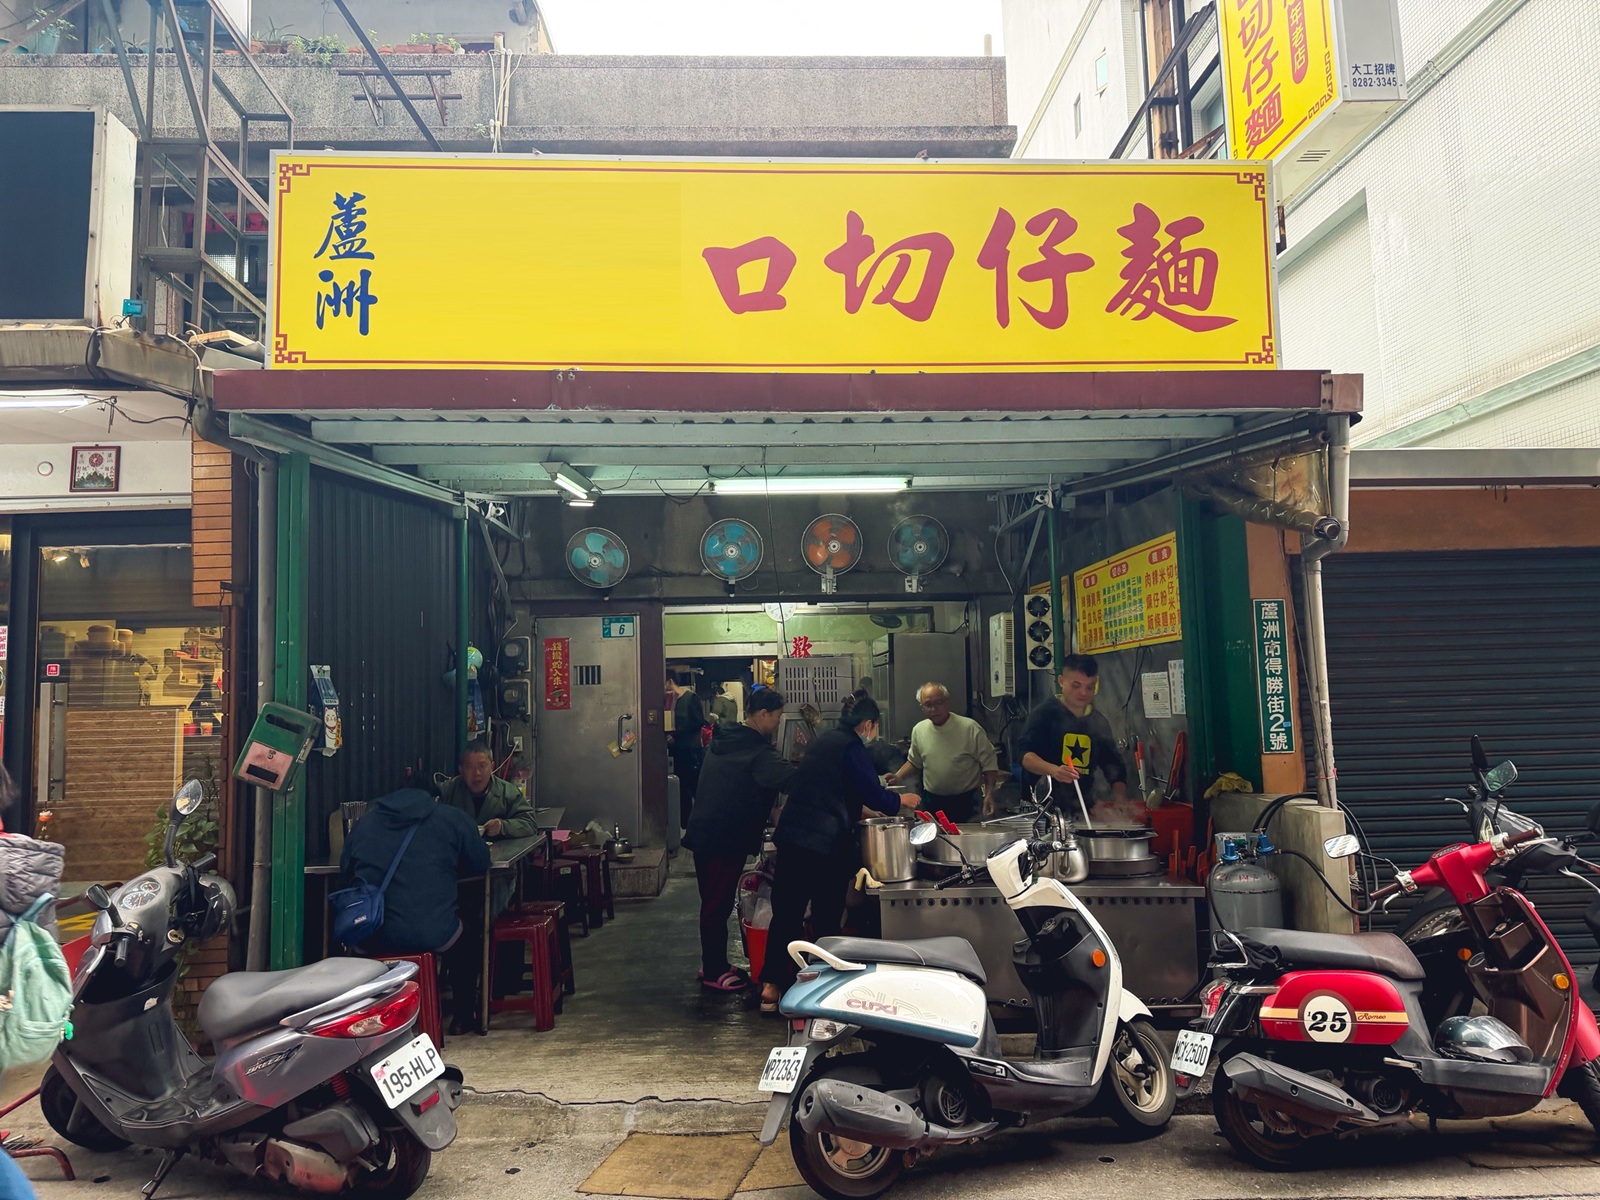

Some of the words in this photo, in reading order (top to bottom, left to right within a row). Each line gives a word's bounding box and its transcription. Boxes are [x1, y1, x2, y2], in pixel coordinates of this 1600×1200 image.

[1351, 62, 1396, 76] 大工招牌
[313, 191, 378, 336] 蘆洲
[702, 202, 1239, 333] 口切仔麵
[618, 624, 625, 635] 6
